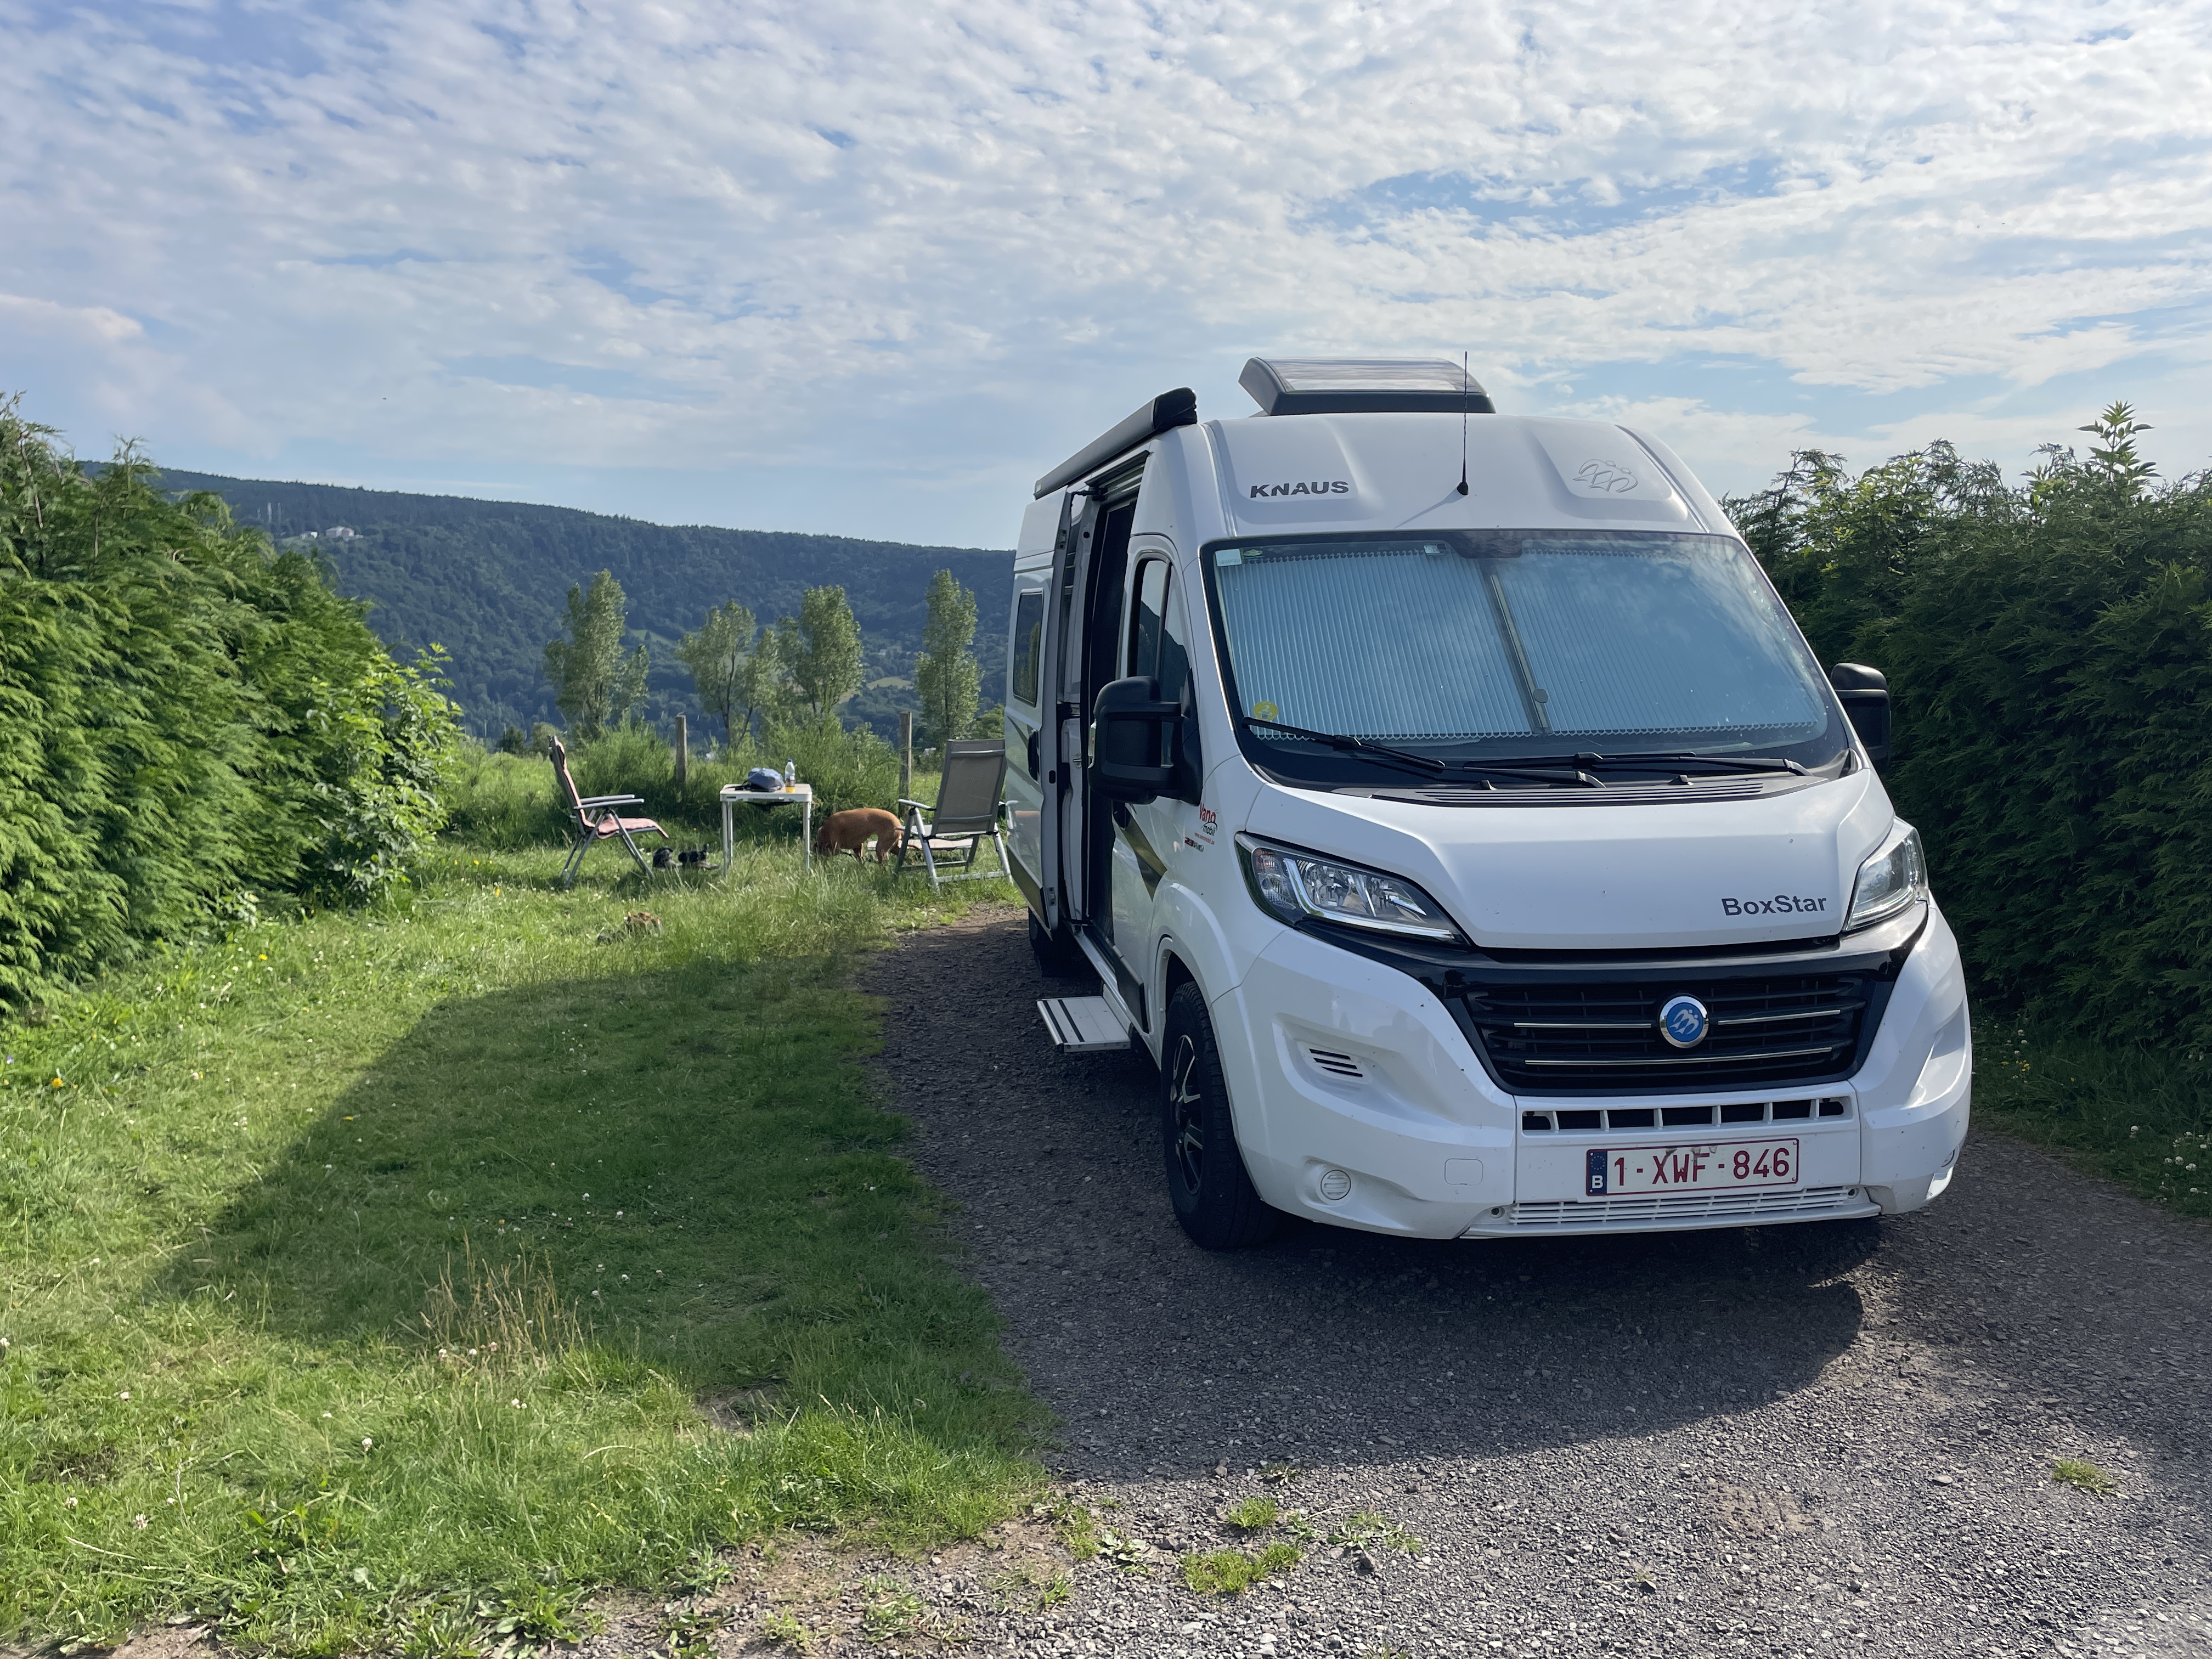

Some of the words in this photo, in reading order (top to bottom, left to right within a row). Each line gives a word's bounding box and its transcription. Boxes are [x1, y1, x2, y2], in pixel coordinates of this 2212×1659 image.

[1250, 481, 1349, 498] KNAUS
[1199, 802, 1216, 823] Vano
[1203, 825, 1216, 837] mobil
[1721, 895, 1827, 916] BoxStar
[1592, 1175, 1604, 1189] B
